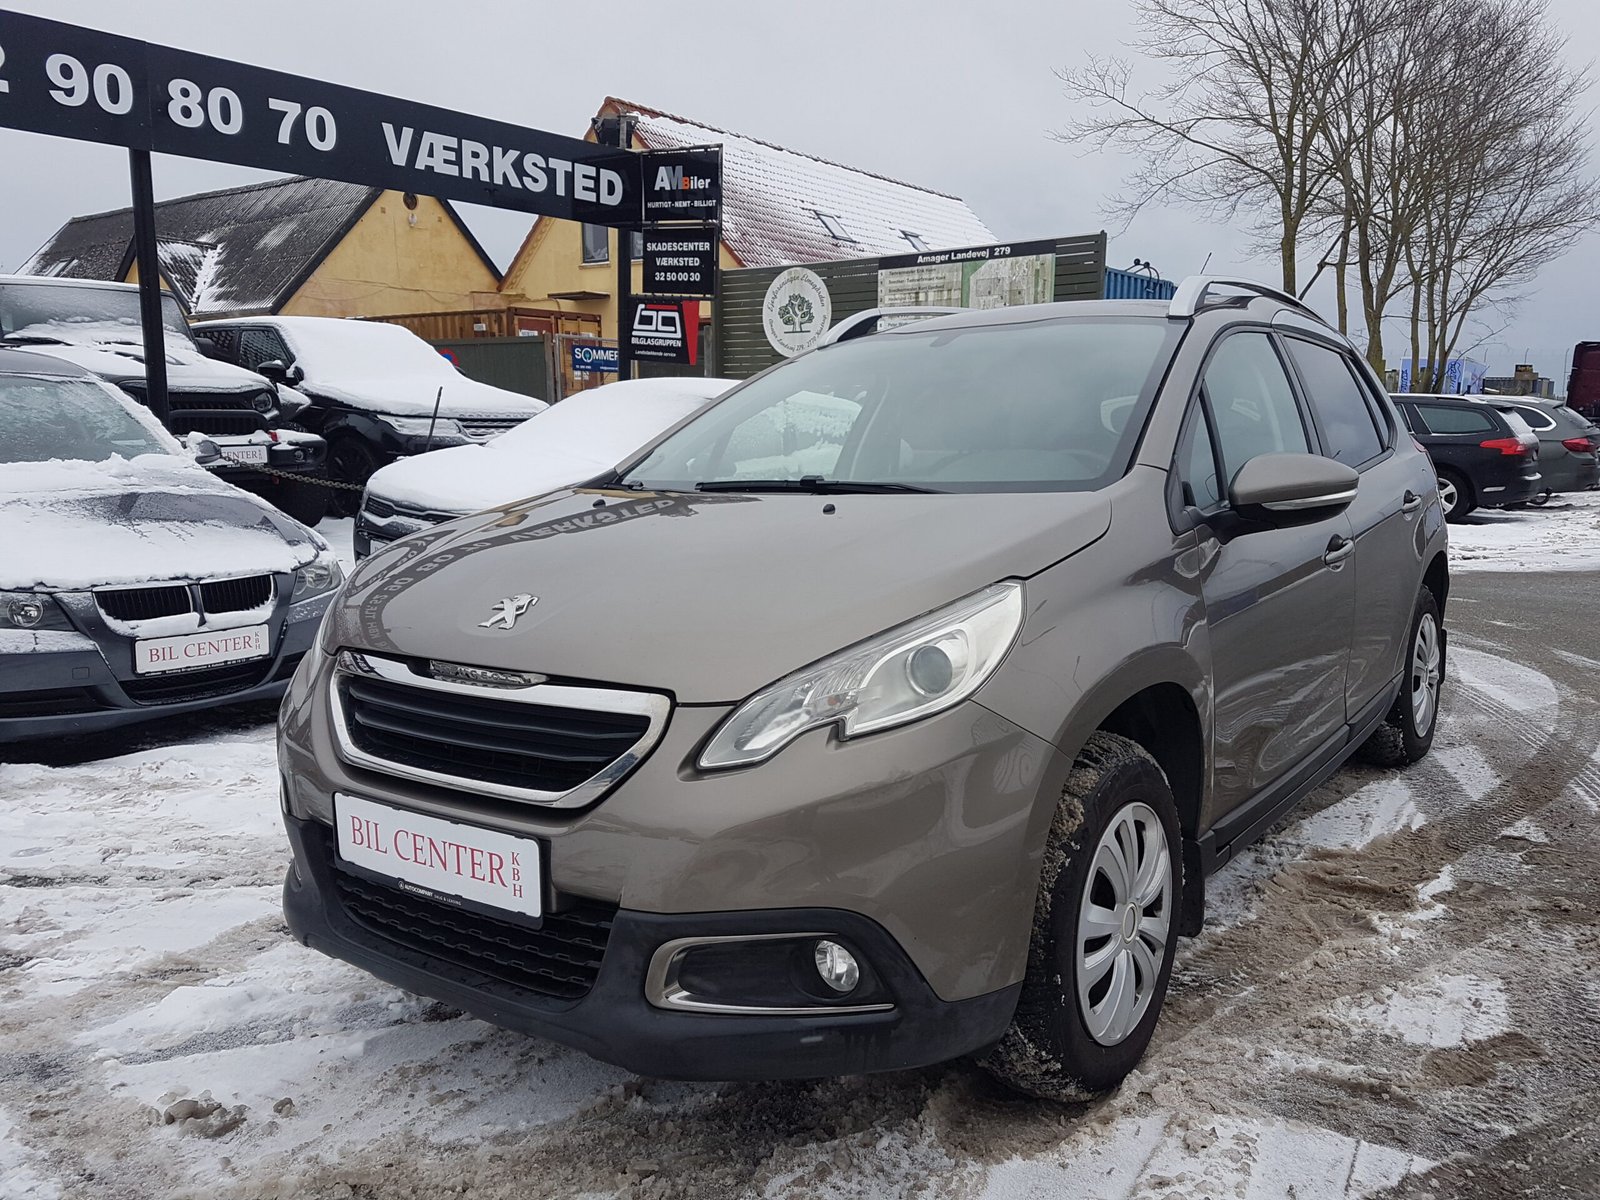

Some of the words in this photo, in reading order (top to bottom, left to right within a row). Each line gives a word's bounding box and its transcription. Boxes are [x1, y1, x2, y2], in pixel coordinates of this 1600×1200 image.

[45, 53, 134, 116] 90
[166, 78, 243, 136] 80
[267, 97, 338, 153] 70
[380, 121, 625, 207] VÆRKSTED
[646, 242, 711, 252] SKADESCENTER
[655, 257, 701, 267] VÆRKSTED
[917, 252, 950, 266] Amager
[950, 248, 990, 263] Landevej
[993, 246, 1012, 257] 279
[654, 272, 665, 282] 32
[666, 272, 677, 282] 50
[677, 272, 689, 282] 00
[689, 272, 701, 283] 30
[631, 337, 682, 348] BILGLASGRUPPEN
[148, 647, 180, 663] BIL
[183, 637, 252, 658] CENTER
[349, 814, 388, 855] BIL
[392, 828, 509, 888] CENTER
